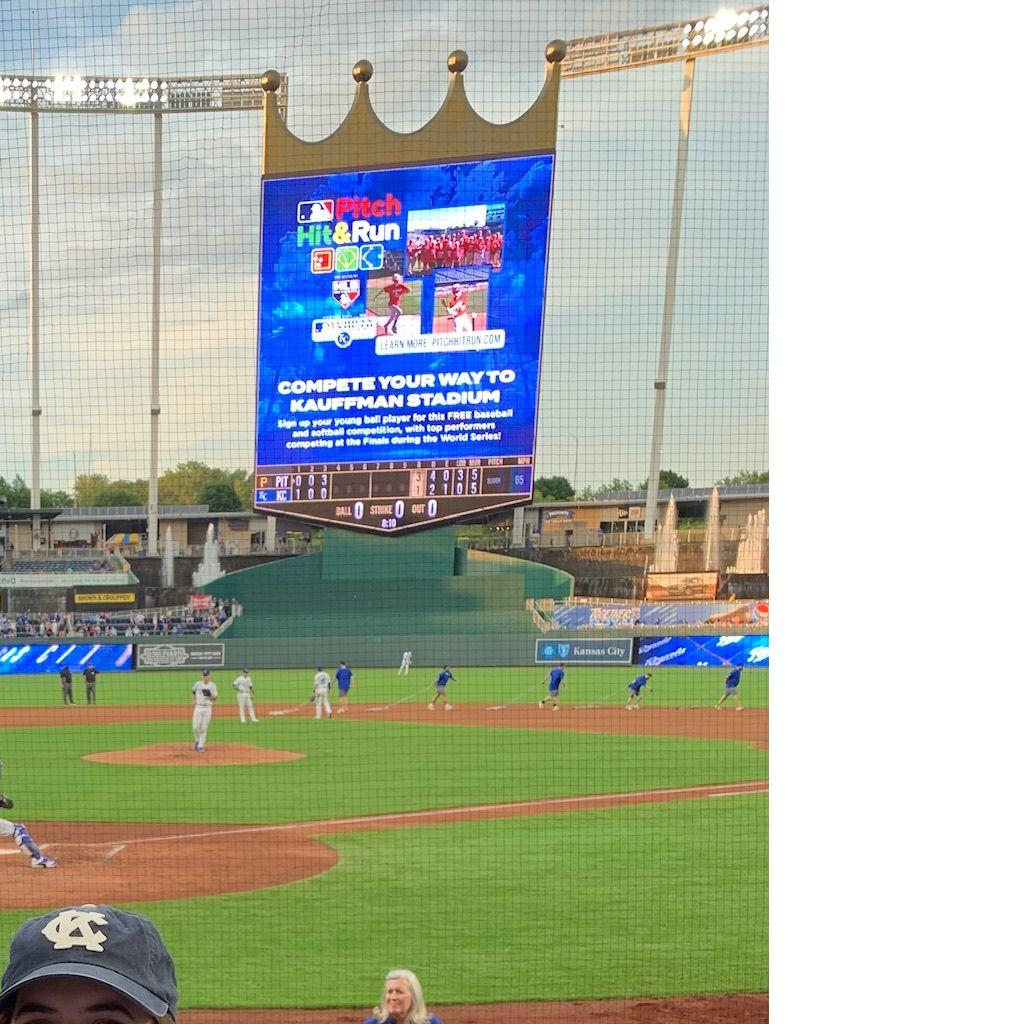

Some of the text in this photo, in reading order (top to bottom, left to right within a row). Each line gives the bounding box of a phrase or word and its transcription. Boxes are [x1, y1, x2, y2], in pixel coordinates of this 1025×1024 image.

[335, 192, 402, 220] Pitch
[297, 220, 401, 247] Hit&Run
[380, 340, 404, 350] LEARN
[407, 339, 427, 348] MORE
[277, 369, 516, 395] COMPETE YOUR WAY TO
[289, 389, 501, 412] KAUFFMAN STADIUM
[277, 408, 513, 429] Sign up your young ball player for this FREE baseball
[292, 422, 496, 438] and softball competition, with top performers
[286, 432, 502, 449] competing at the Finals during the World Series!
[275, 476, 289, 488] PIT
[296, 475, 302, 486] 0
[308, 475, 314, 486] 0
[322, 474, 328, 485] 3
[416, 471, 421, 482] 3
[429, 469, 436, 481] 4
[443, 469, 449, 481] 0
[457, 469, 463, 480] 3
[471, 469, 478, 480] 5
[276, 490, 287, 501] KC
[296, 489, 300, 499] 1
[308, 488, 314, 499] 0
[321, 487, 327, 499] 0
[416, 485, 420, 495] 1
[429, 484, 436, 495] 2
[443, 483, 448, 495] 1
[457, 483, 463, 495] 0
[471, 482, 477, 495] 5
[336, 499, 437, 519] BALL 0 STRIKE 0 OUT 0
[573, 646, 625, 657] Kansas City
